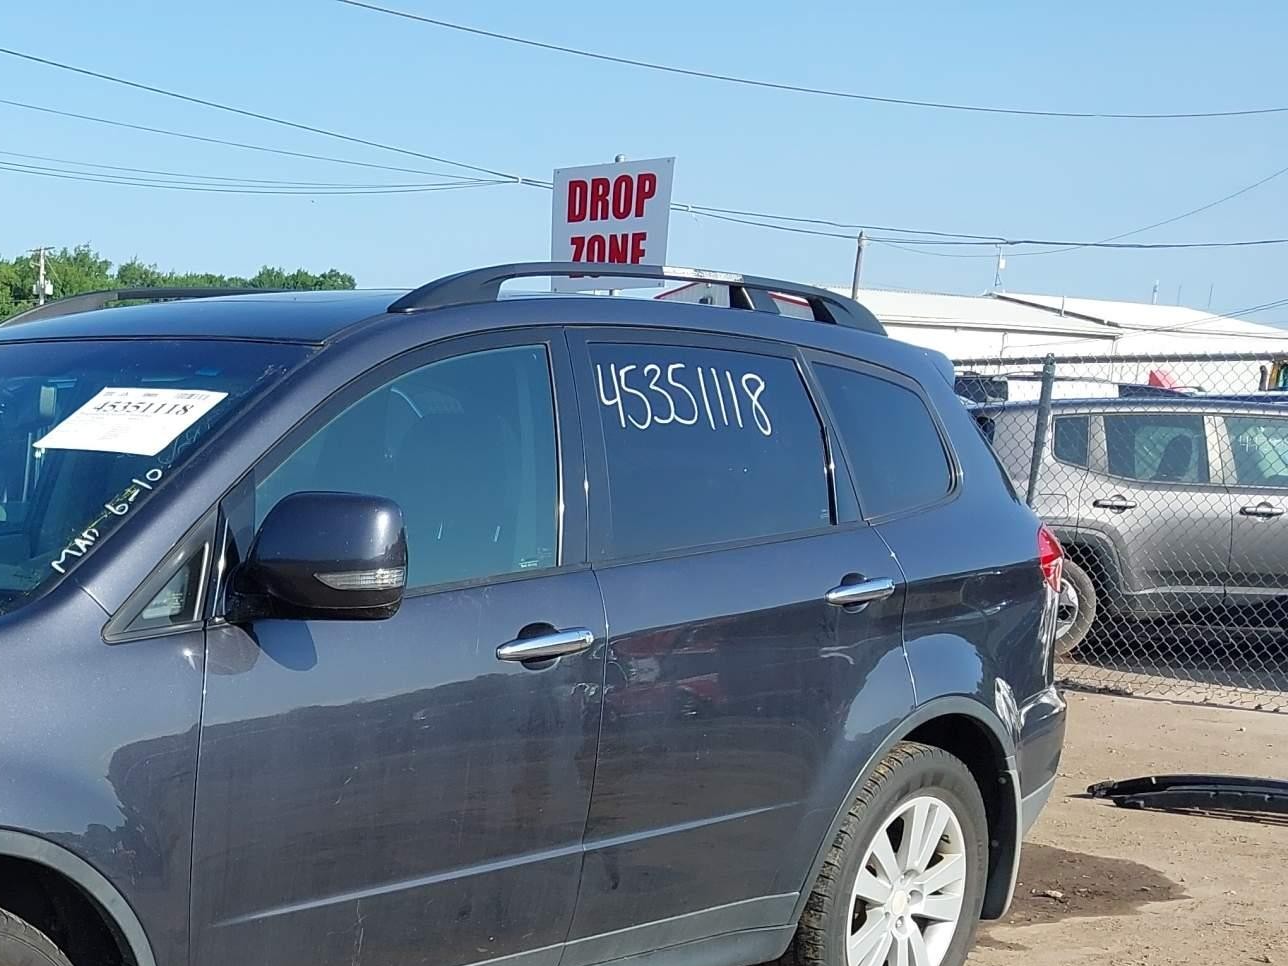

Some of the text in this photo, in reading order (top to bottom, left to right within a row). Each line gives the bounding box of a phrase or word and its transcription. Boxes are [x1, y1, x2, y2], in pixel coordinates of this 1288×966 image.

[567, 173, 657, 223] DROP
[569, 232, 647, 278] ZONE
[93, 400, 194, 416] 45351118
[597, 363, 772, 436] 45351118
[105, 468, 162, 516] 6-10
